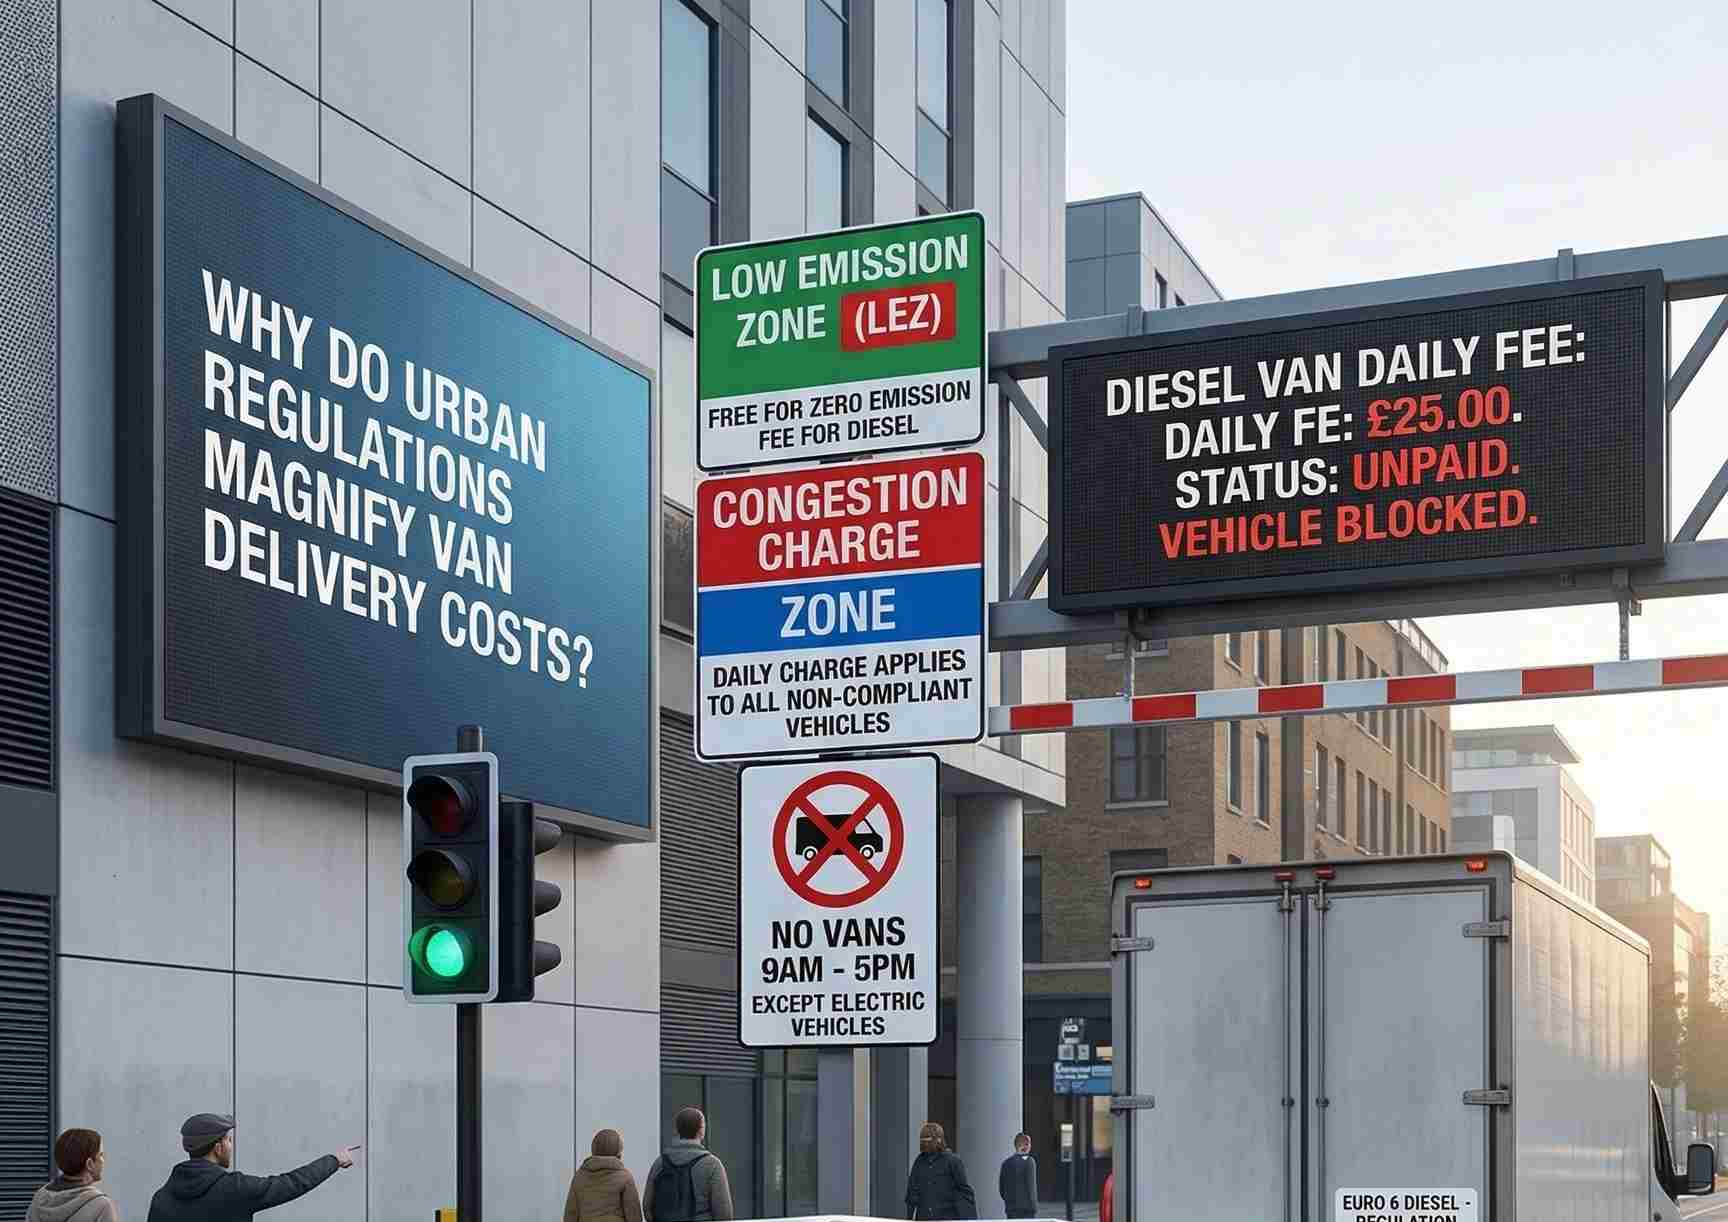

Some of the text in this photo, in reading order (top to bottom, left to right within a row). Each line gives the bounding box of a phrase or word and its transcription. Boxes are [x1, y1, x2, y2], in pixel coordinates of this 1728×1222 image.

[712, 234, 968, 301] LOW EMISSION
[736, 293, 942, 347] ZONE (LEZ)
[202, 268, 547, 472] WHY DO URBAN
[1106, 323, 1585, 417] DIESEL VAN DAILY FEE:
[708, 380, 971, 429] FREE FOR ZERO EMISSION
[205, 349, 513, 526] REGULATIONS
[759, 415, 919, 450] FEE FOR DIESEL
[1165, 411, 1278, 460] DAILY
[1293, 404, 1353, 446] FE:
[713, 467, 967, 528] CONGESTION
[1175, 438, 1520, 510] STATUS: UNPAID.
[205, 429, 513, 595] MAGNIFY VAN
[1159, 488, 1538, 560] VEHICLE BLOCKED.
[759, 520, 920, 571] CHARGE
[205, 508, 594, 688] DELIVERY COSTS?
[780, 588, 896, 638] ZONE
[713, 649, 966, 688] DAILY CHARGE APPLIES
[708, 678, 972, 716] TO ALL NON-COMPLIANT
[786, 712, 890, 738] VEHICLES
[771, 916, 906, 949] NO VANS
[761, 955, 823, 983] 9AM
[854, 953, 916, 981] 5PM
[752, 991, 925, 1014] EXCEPT ELECTRIC
[791, 1016, 885, 1037] VEHICLES
[1343, 1195, 1385, 1210] EURO
[1390, 1195, 1399, 1210] 6
[1404, 1195, 1459, 1210] DIESEL
